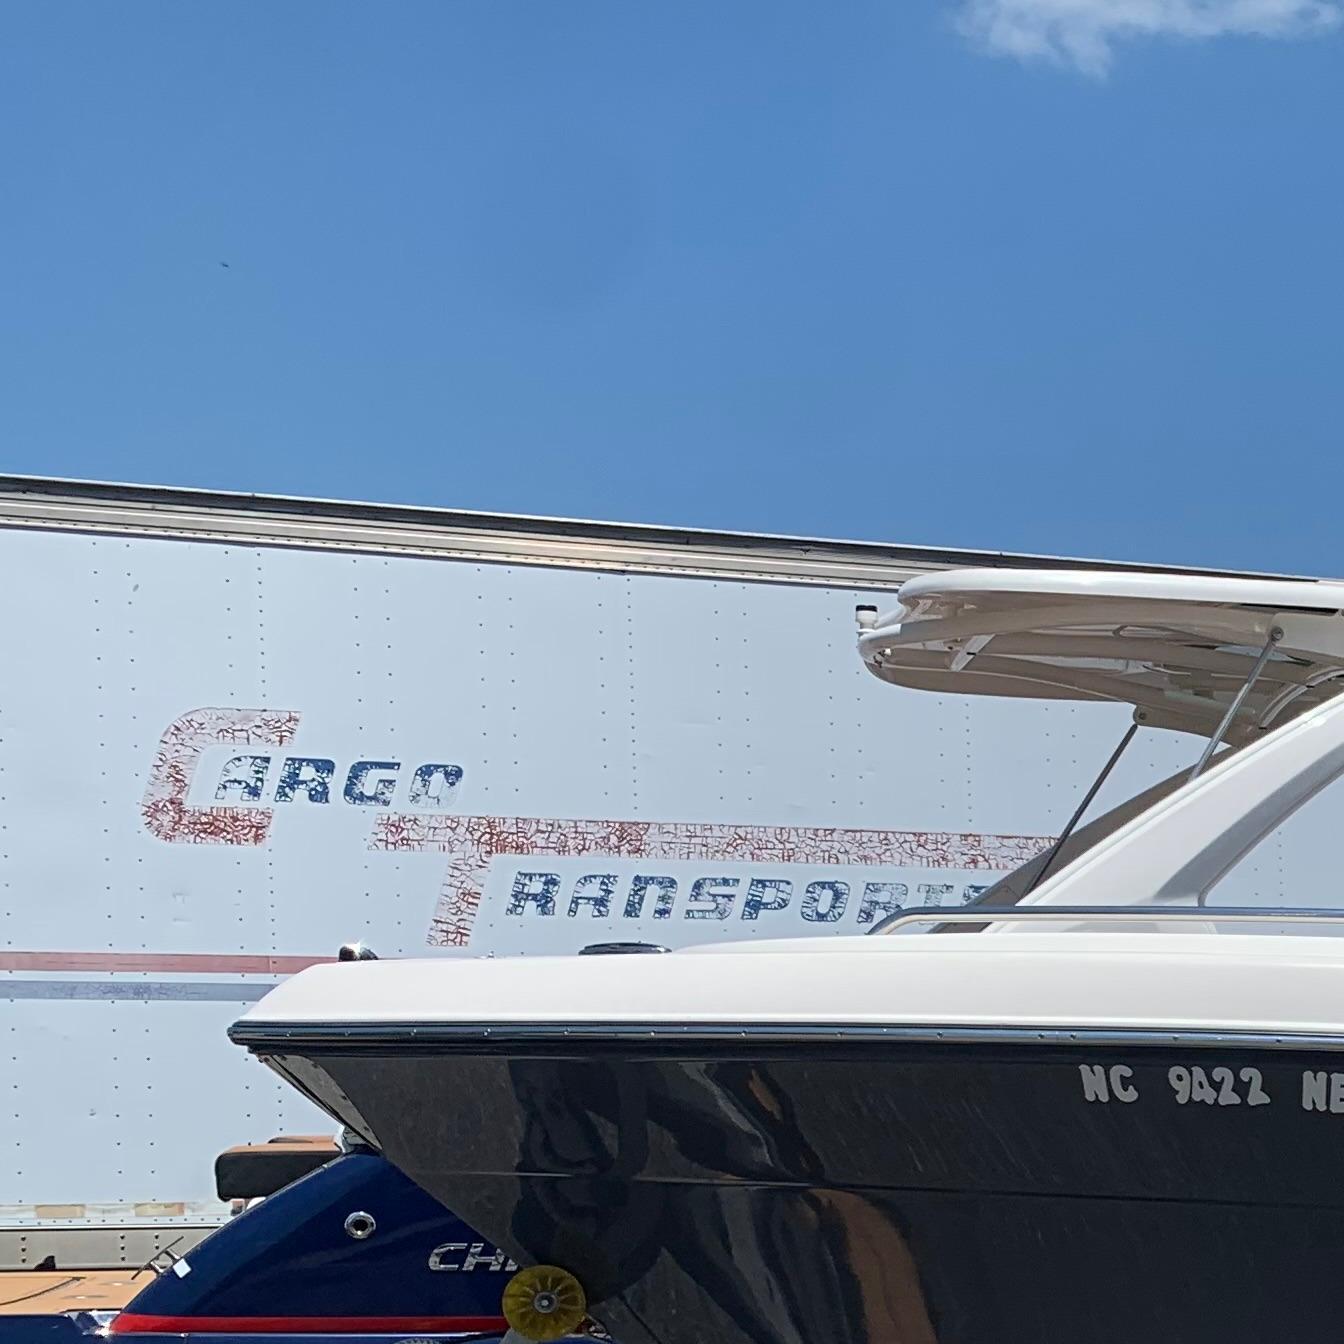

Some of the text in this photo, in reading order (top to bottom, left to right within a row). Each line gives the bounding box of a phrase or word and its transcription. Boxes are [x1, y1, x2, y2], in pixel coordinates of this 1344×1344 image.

[142, 706, 465, 847] CARGO
[1078, 1063, 1139, 1103] NC
[1167, 1065, 1271, 1106] 9422
